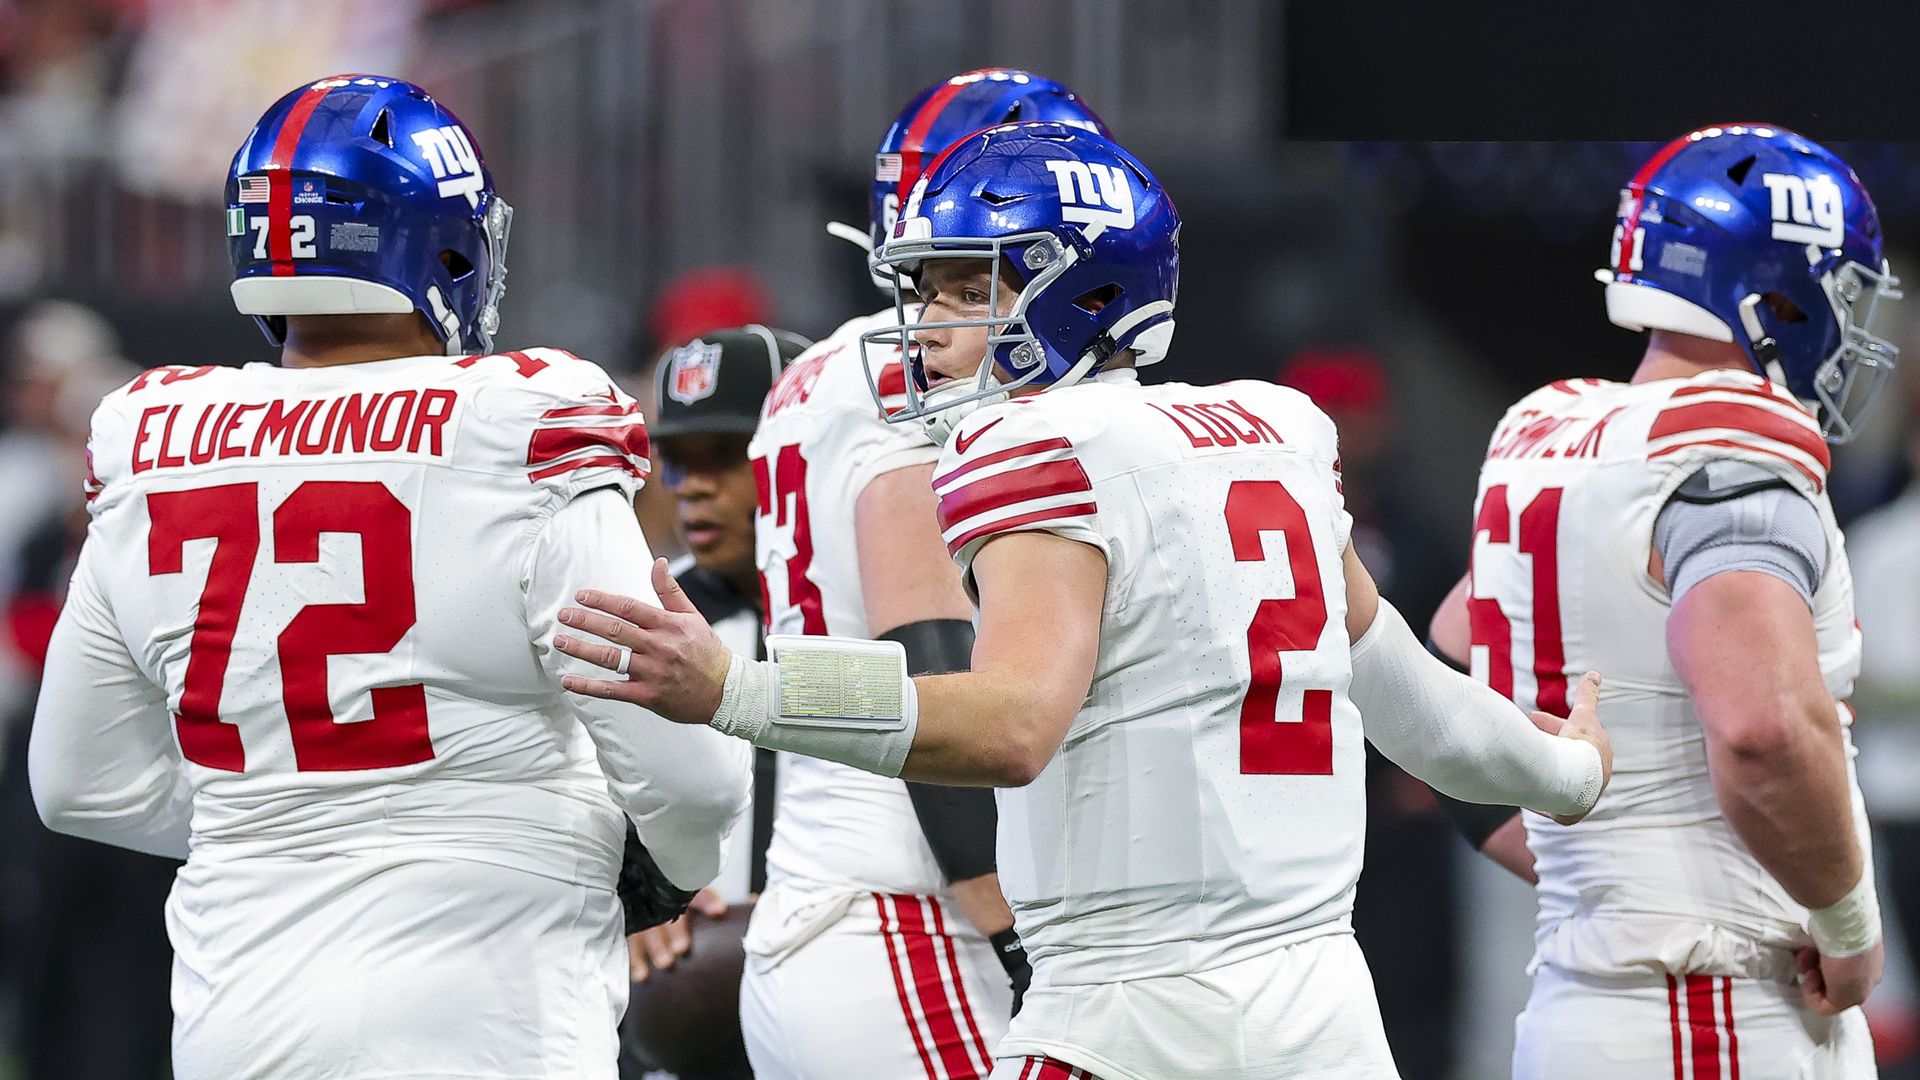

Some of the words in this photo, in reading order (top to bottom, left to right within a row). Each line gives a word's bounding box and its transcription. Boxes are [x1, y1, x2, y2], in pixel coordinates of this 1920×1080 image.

[410, 125, 484, 211] ny
[1045, 160, 1135, 230] ny
[250, 215, 317, 260] 72
[1763, 173, 1845, 248] ny
[131, 388, 457, 475] ELUEMUNOR
[1145, 399, 1285, 449] LOCK
[146, 481, 436, 773] 72
[1224, 480, 1334, 776] 2
